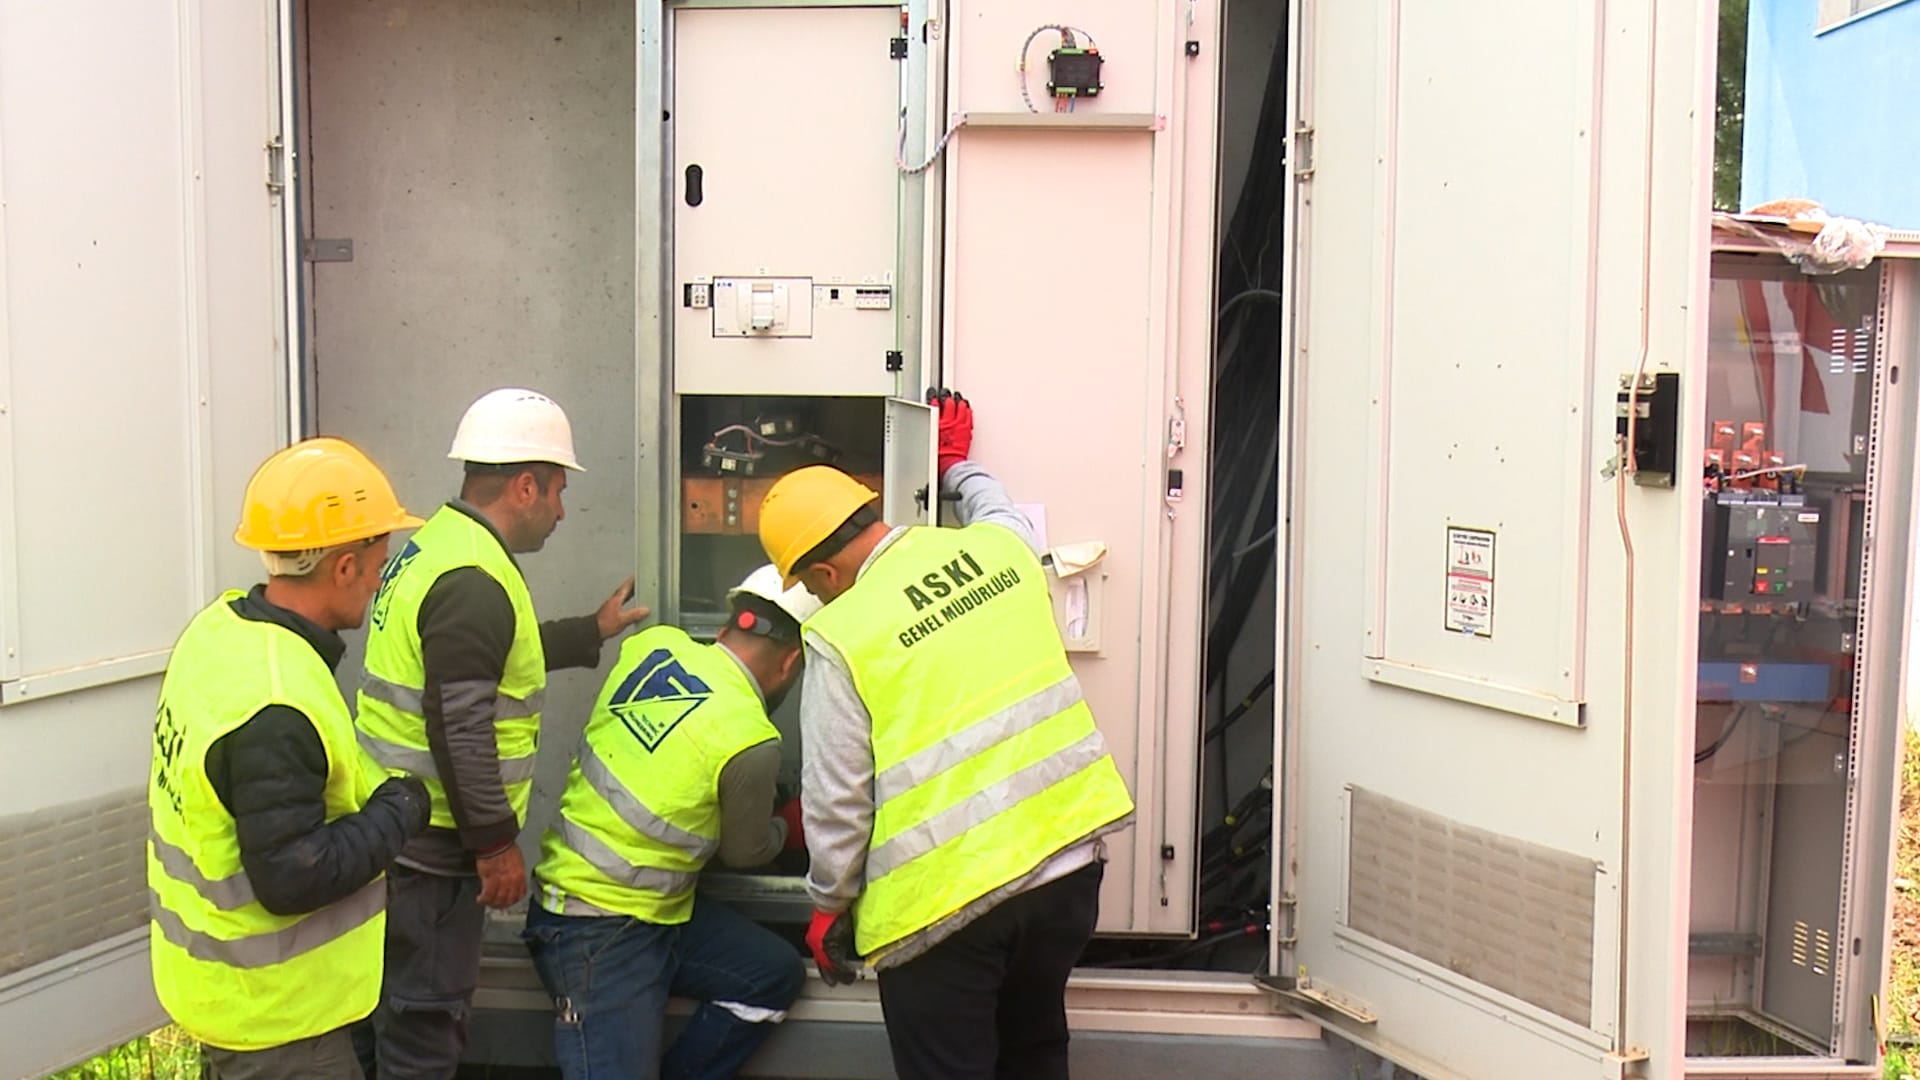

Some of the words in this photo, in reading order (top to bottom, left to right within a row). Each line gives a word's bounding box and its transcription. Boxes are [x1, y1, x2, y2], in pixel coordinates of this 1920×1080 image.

[898, 614, 944, 648] GENEL
[940, 566, 1021, 623] MÜDÜRLÜĞÜ
[903, 549, 984, 612] ASKİ
